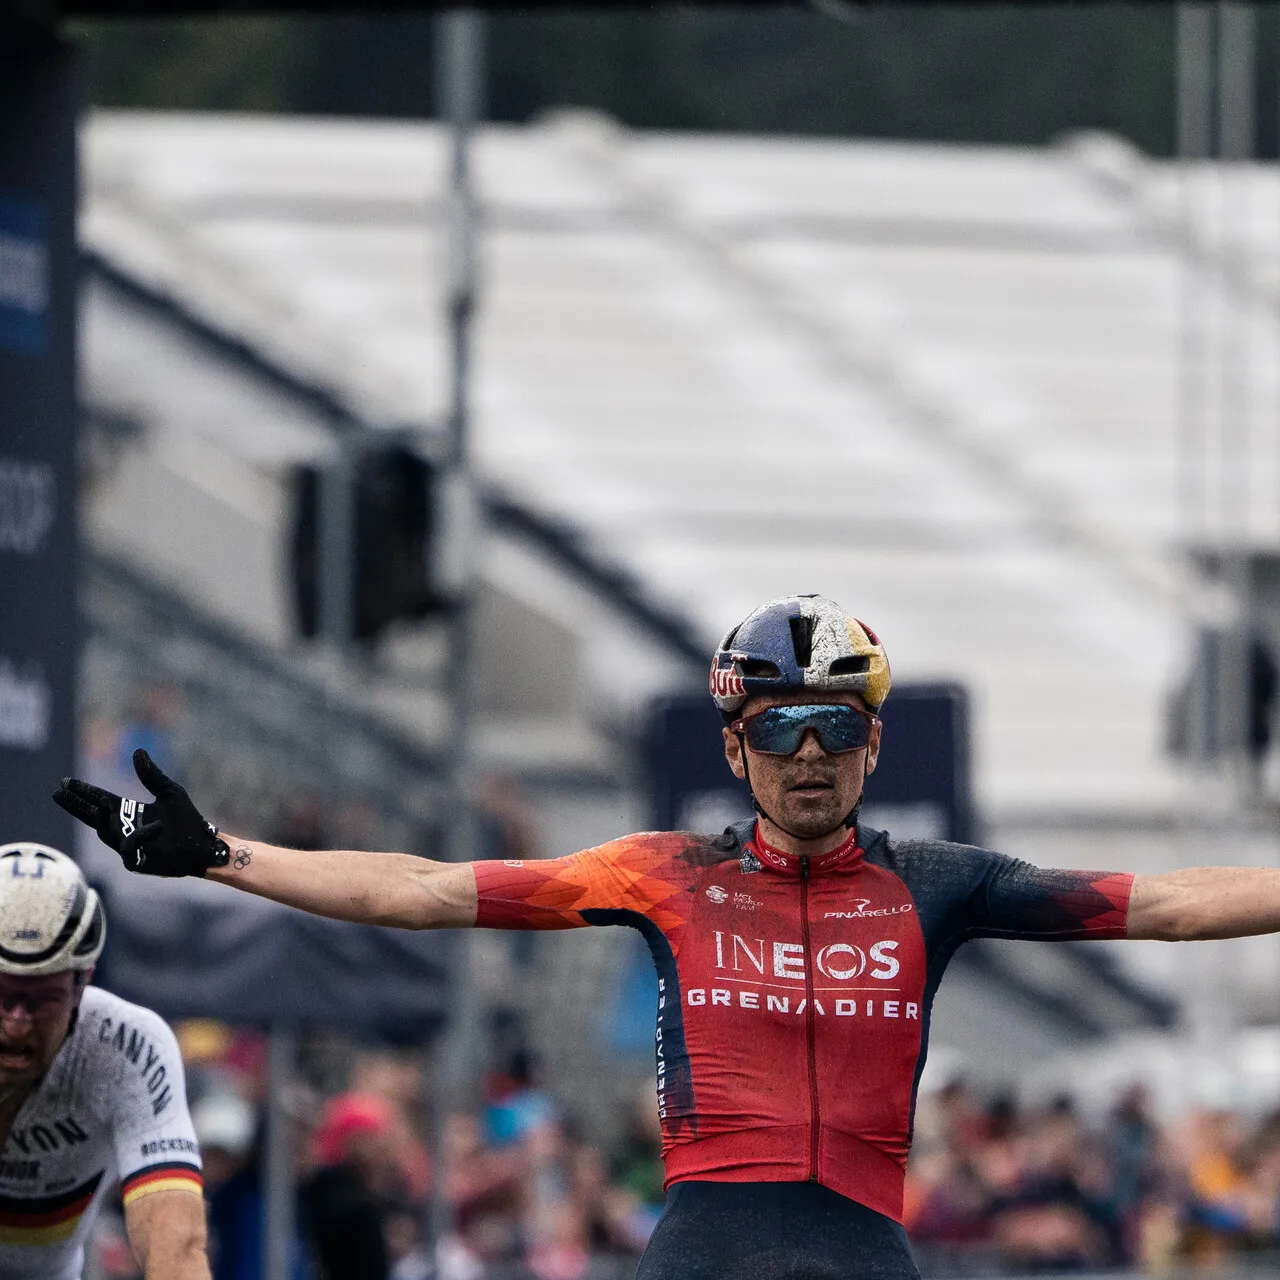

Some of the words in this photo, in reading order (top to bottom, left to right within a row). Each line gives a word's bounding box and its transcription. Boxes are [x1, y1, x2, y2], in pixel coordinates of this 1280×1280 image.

[823, 902, 913, 919] PINARELLO
[712, 930, 901, 980] INEOS
[687, 987, 919, 1021] GRENADIER
[99, 1016, 173, 1117] CANYON
[655, 976, 666, 1119] GRENADIER
